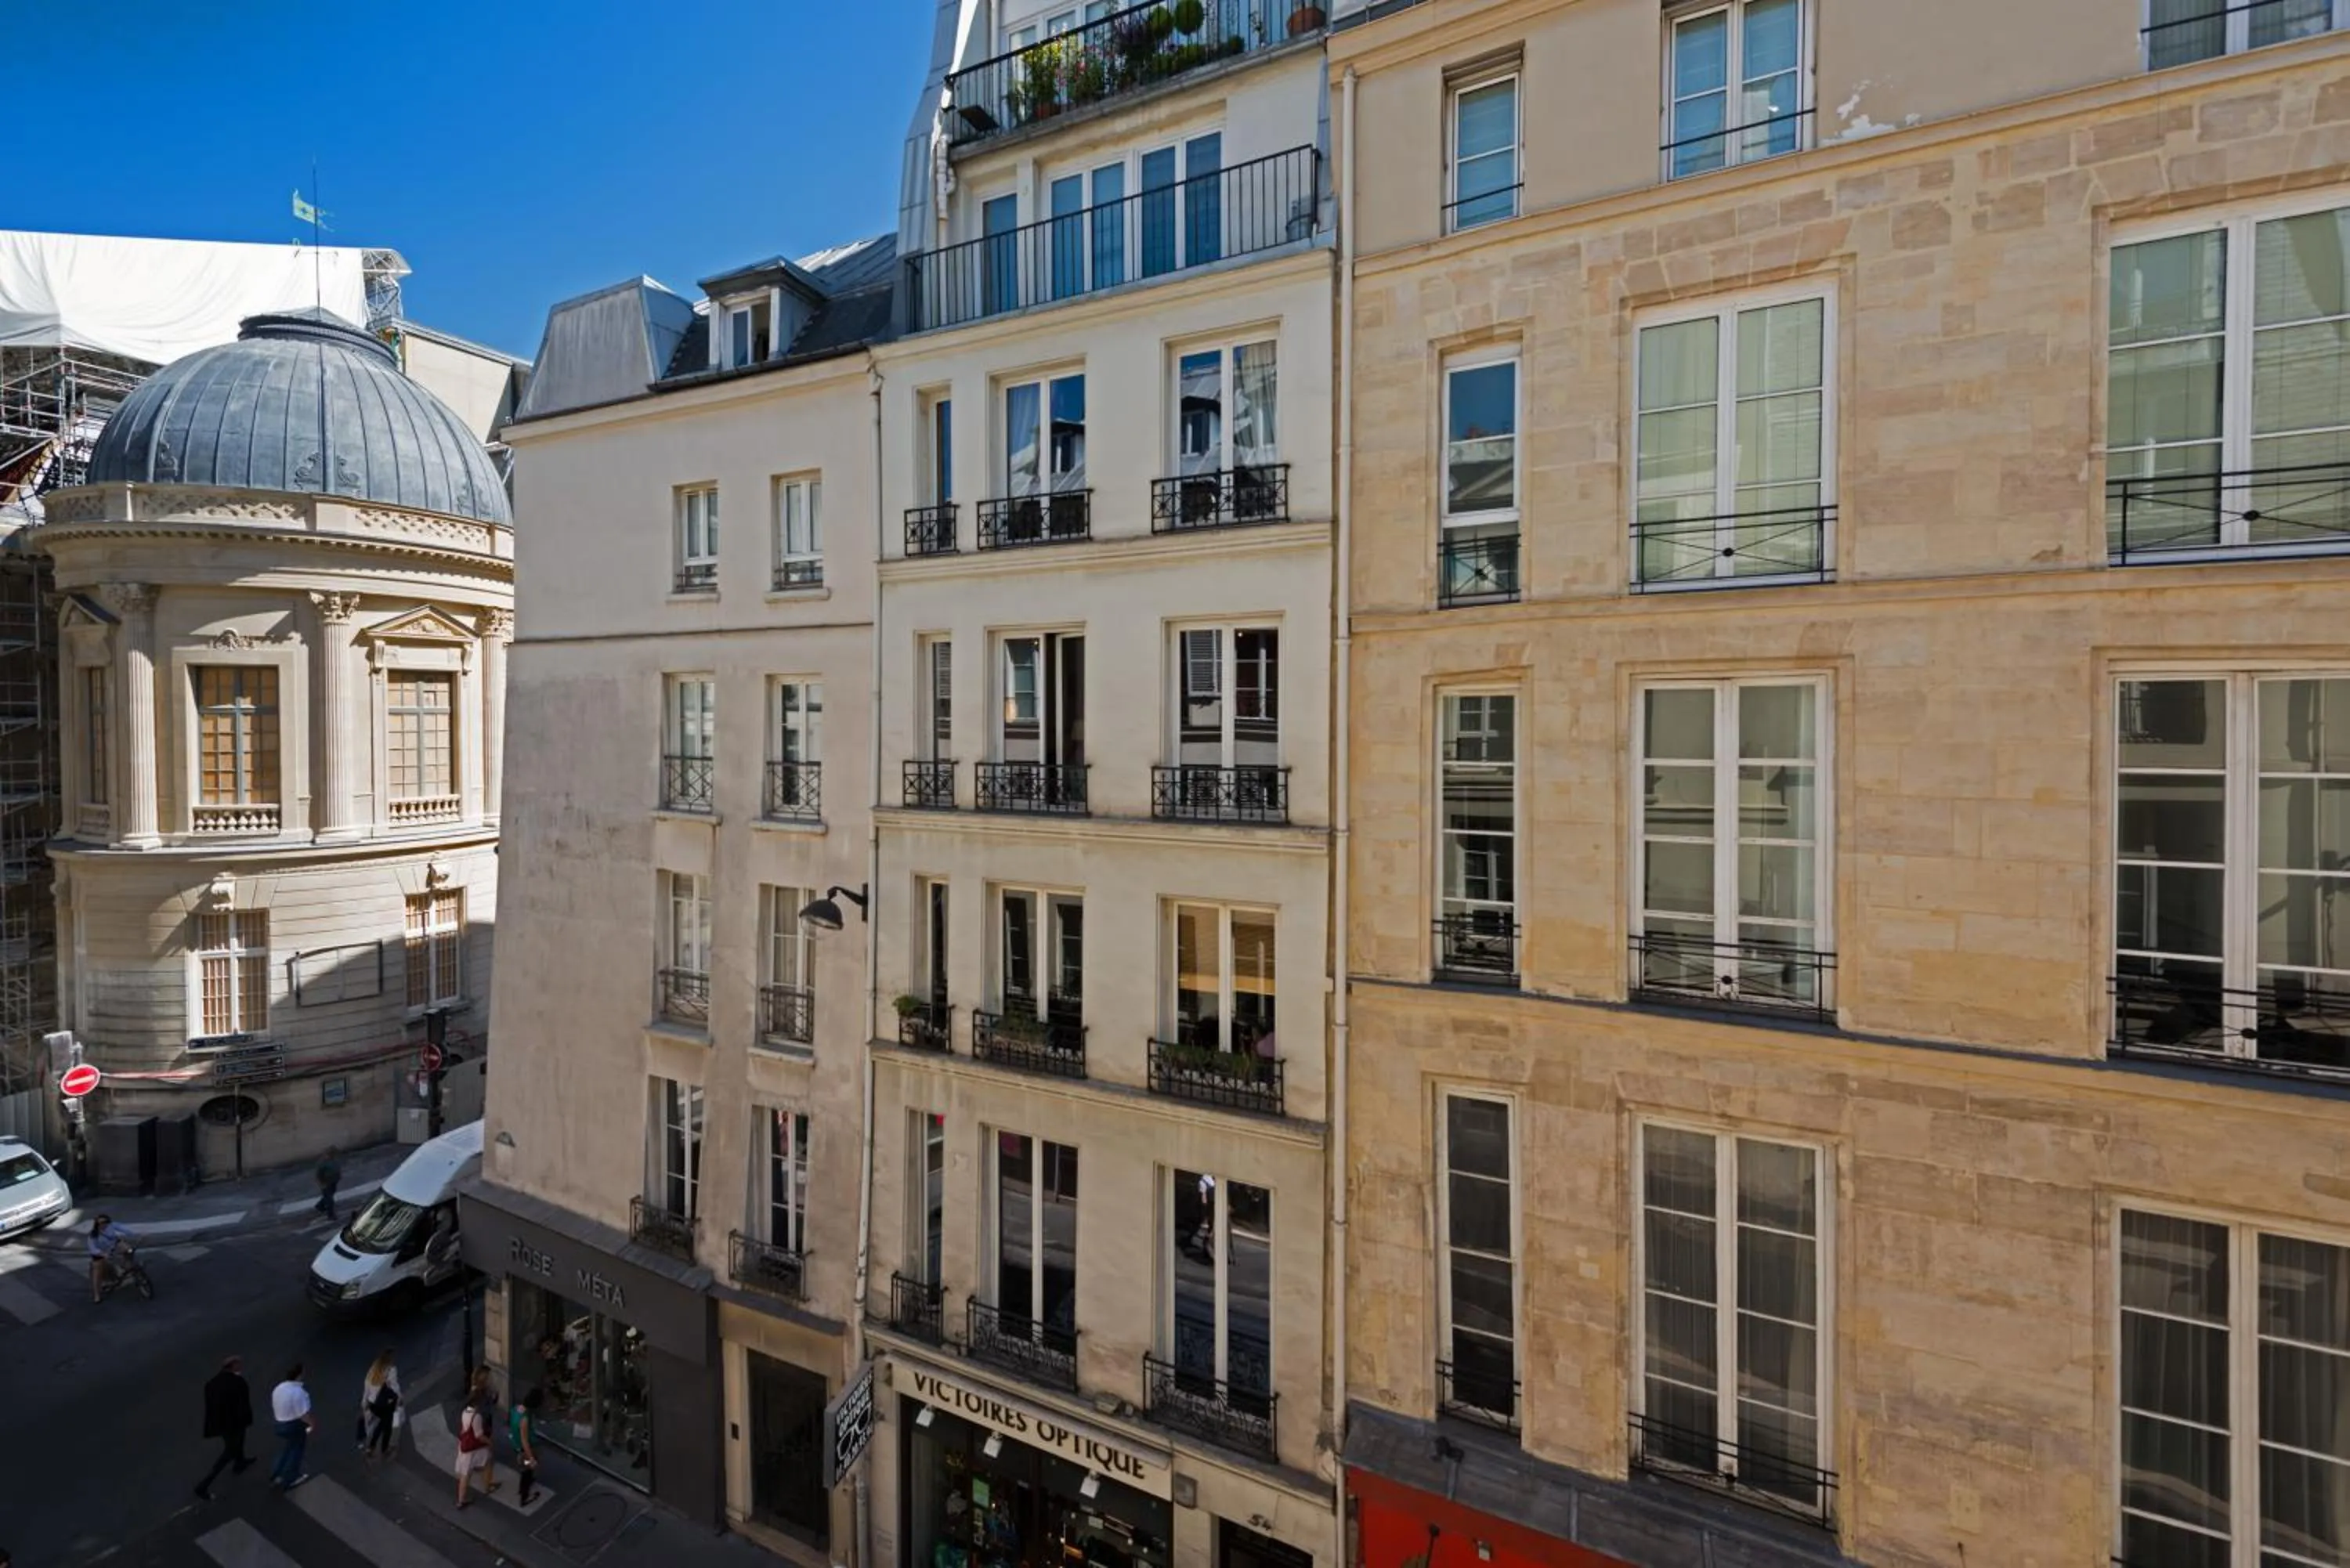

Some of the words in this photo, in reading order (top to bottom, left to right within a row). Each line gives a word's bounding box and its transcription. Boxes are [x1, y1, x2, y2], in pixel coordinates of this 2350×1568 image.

[510, 1235, 552, 1277] ROSE
[913, 1372, 1028, 1433] VICTOIRES
[1036, 1420, 1145, 1479] OPTIQUE
[1247, 1514, 1271, 1531] 54
